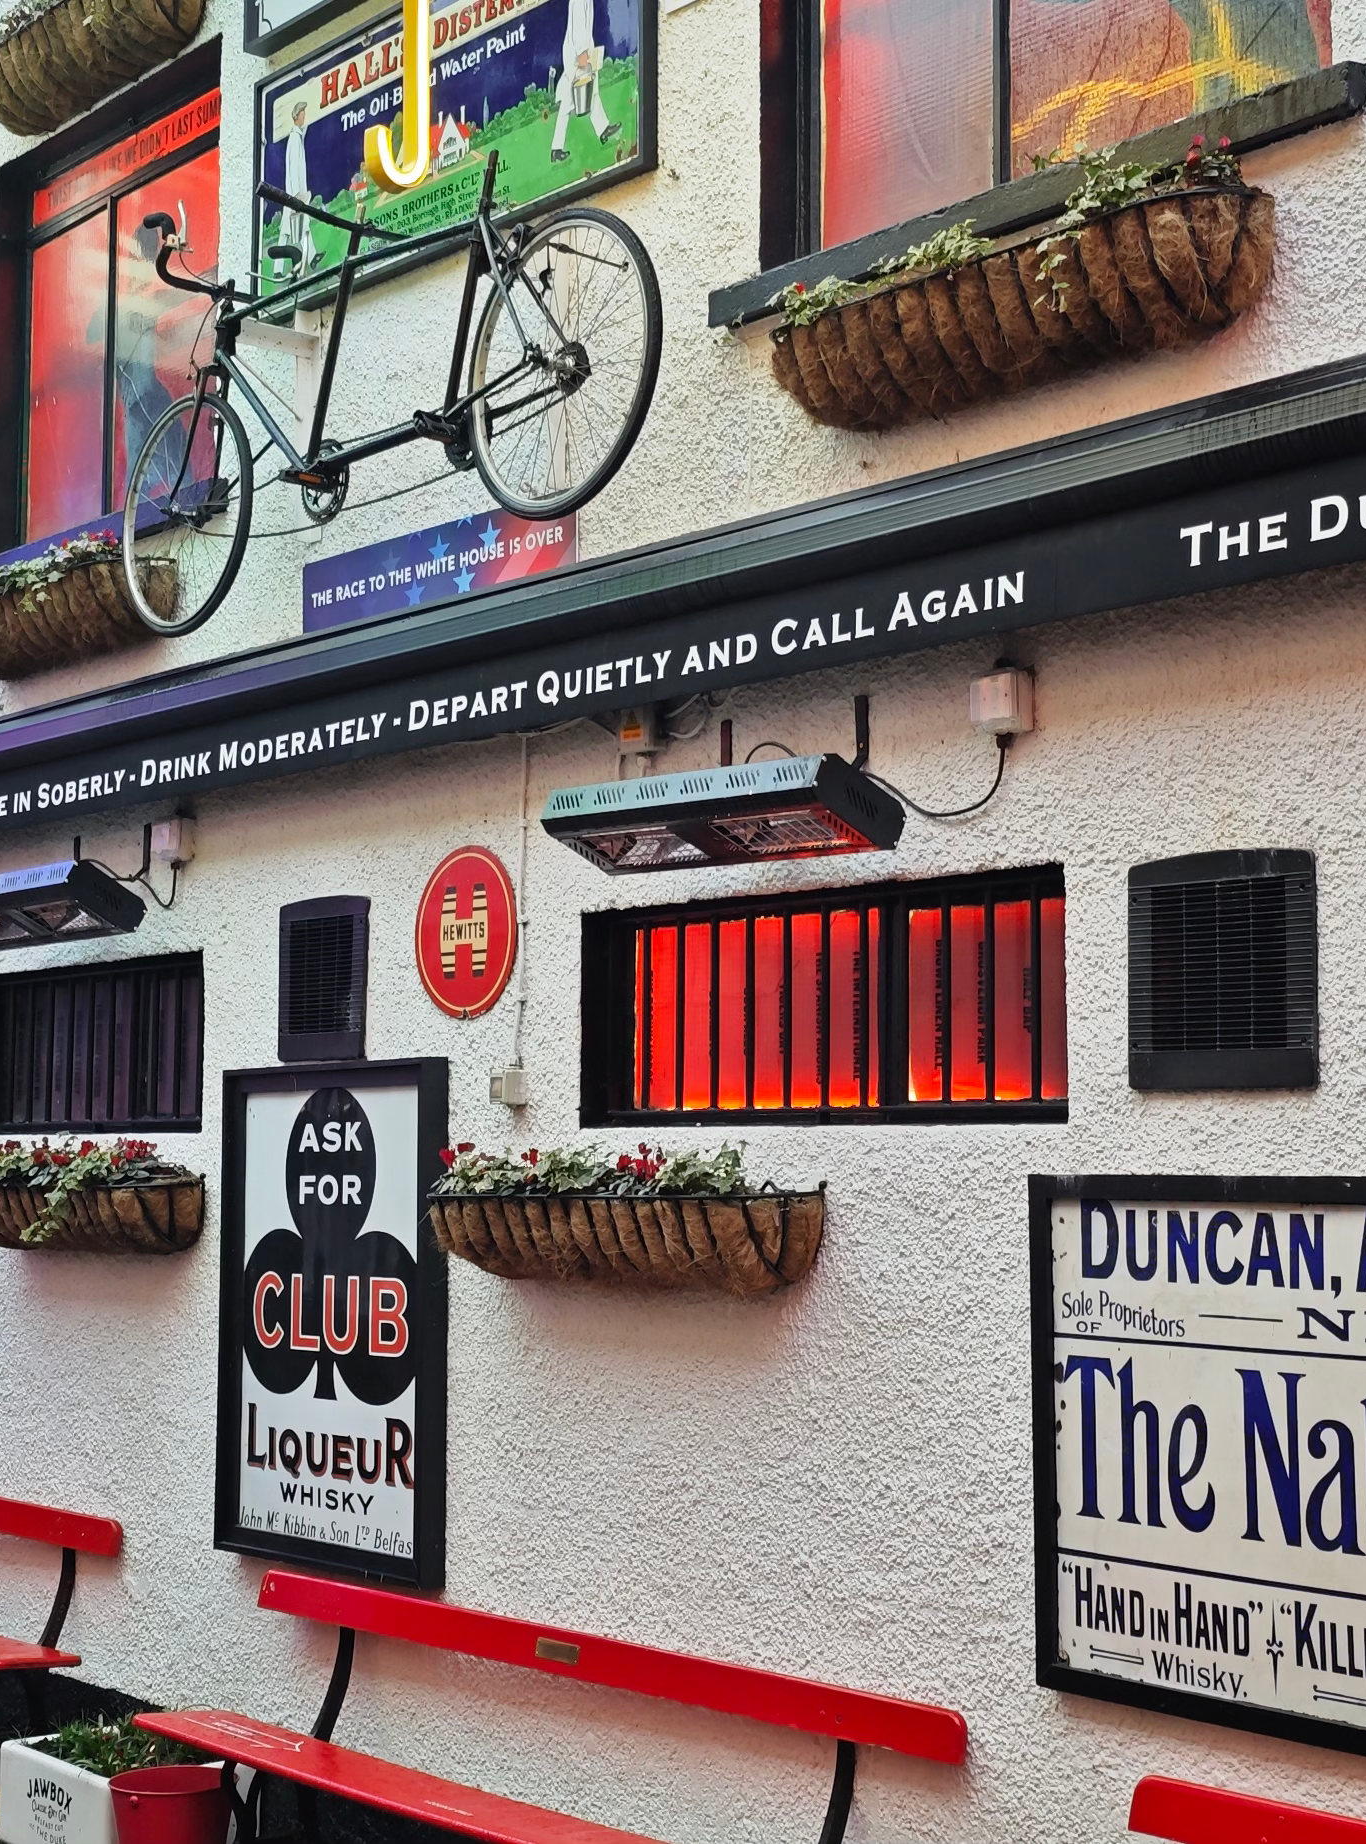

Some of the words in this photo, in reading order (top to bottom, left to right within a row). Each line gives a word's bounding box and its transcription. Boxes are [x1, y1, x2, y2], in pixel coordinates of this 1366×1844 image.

[341, 108, 365, 131] The
[440, 47, 484, 81] Water
[486, 23, 526, 59] Paint
[104, 152, 122, 174] LIKE
[139, 124, 169, 159] DIDN'T
[171, 110, 195, 141] LAST
[402, 184, 453, 214] BROTHERS
[1180, 512, 1288, 567] THE
[311, 590, 333, 608] THE
[335, 581, 366, 603] RACE
[369, 576, 385, 592] TO
[388, 567, 412, 588] THE
[415, 557, 457, 580] WHITE
[460, 543, 504, 569] HOUSE
[509, 537, 521, 556] IS
[525, 526, 564, 551] OVER
[12, 790, 32, 812] IN
[37, 767, 127, 809] SOBERLY
[140, 751, 211, 787] DRINK
[219, 712, 388, 771] MODERATELY
[407, 680, 528, 730] DEPART
[537, 649, 672, 706] QUIETLY
[681, 634, 758, 676] AND
[771, 606, 875, 656] CALL
[888, 571, 1026, 632] AGAIN
[442, 923, 485, 942] HEWITTS
[299, 1121, 363, 1153] ASK
[299, 1174, 362, 1206] FOR
[1080, 1199, 1342, 1299] DUNCAN,
[253, 1270, 409, 1359] CLUB
[1061, 1290, 1094, 1319] Sole
[1099, 1290, 1186, 1338] Proprietors
[1075, 1320, 1102, 1334] OF
[245, 1402, 414, 1490] LIQUEUR
[1063, 1355, 1216, 1534] The
[279, 1482, 374, 1516] WHISKY
[239, 1506, 262, 1528] John
[284, 1513, 316, 1539] Kibbin
[319, 1528, 326, 1539] &
[329, 1521, 349, 1544] Son
[1150, 1608, 1169, 1643] IN
[27, 1778, 72, 1815] JAWBOX
[37, 1826, 47, 1841] THE
